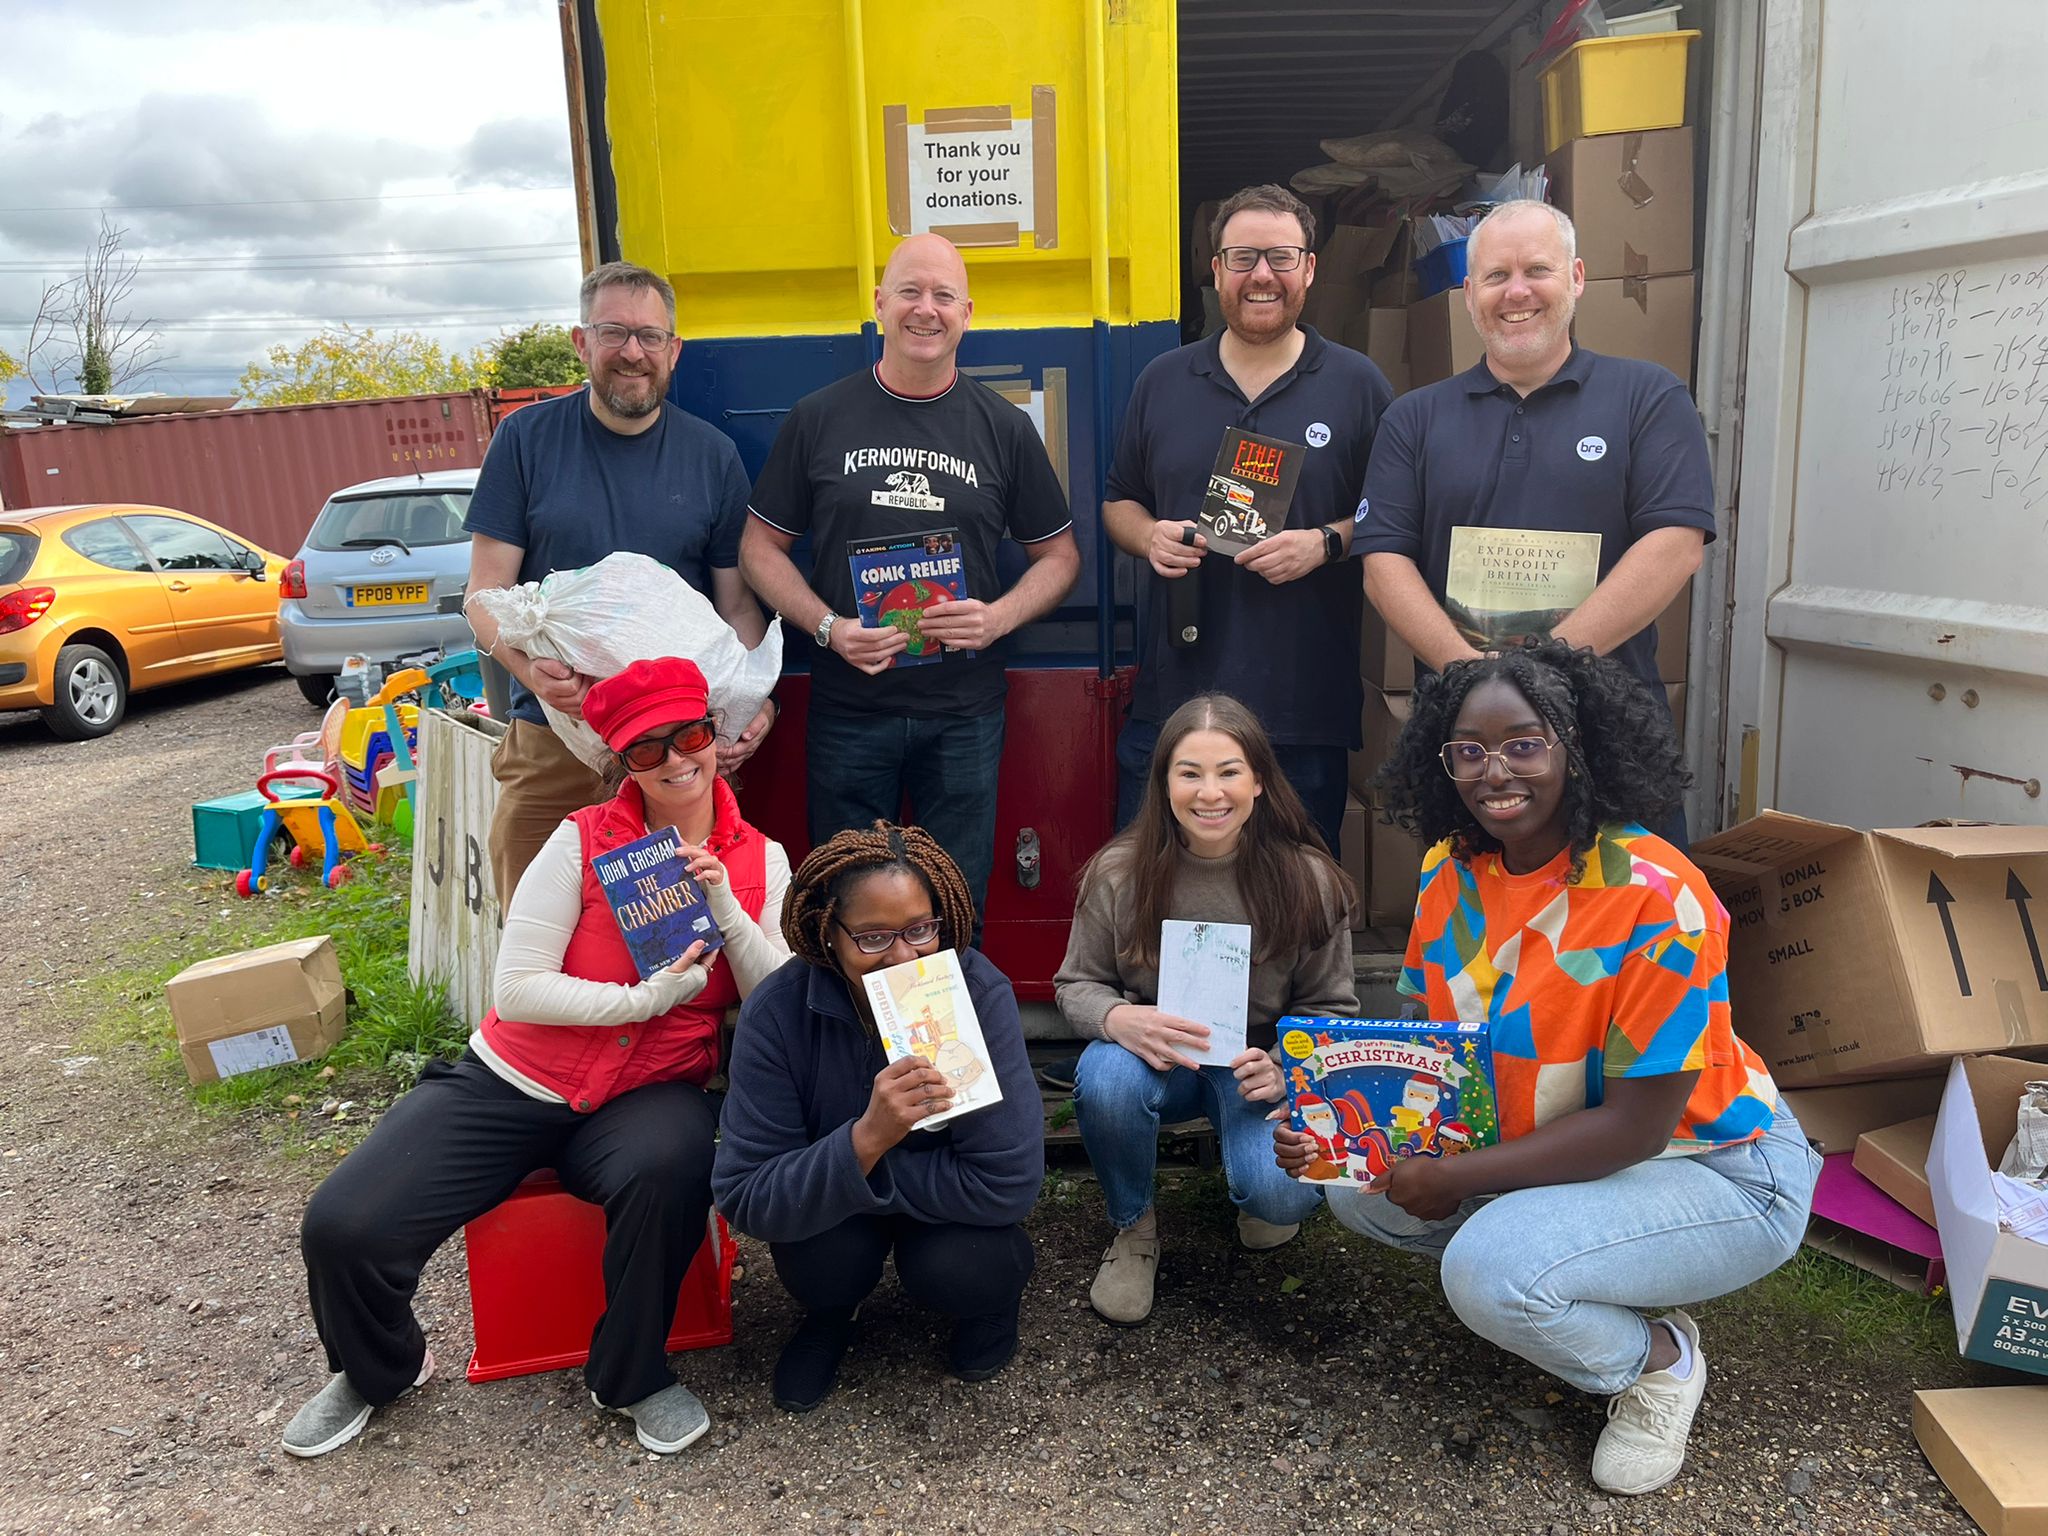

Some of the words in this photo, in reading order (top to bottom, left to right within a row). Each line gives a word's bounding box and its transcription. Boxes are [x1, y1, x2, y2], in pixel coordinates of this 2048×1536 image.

[924, 141, 981, 159] Thank
[986, 143, 1021, 161] you
[937, 167, 963, 183] for
[968, 168, 1010, 186] your
[926, 191, 1022, 208] donations.
[1308, 427, 1328, 442] bre
[1580, 441, 1603, 454] bre
[1234, 439, 1284, 478] ETHEL
[844, 448, 979, 488] KERNOWFORNIA
[888, 495, 928, 509] REPUBLIC
[1478, 545, 1566, 560] EXPLORING
[860, 564, 906, 585] COMIC
[910, 557, 961, 579] RELIEF
[1482, 557, 1559, 571] UNSPOILT
[1487, 570, 1550, 582] BRITAIN
[357, 587, 393, 603] FP08
[397, 585, 425, 600] YPF
[599, 856, 630, 886] JOHN
[627, 838, 678, 873] GRISHAM
[634, 873, 661, 897] THE
[1793, 884, 1825, 909] BOX
[616, 880, 699, 932] CHAMBER
[1767, 938, 1814, 965] SMALL
[1327, 1019, 1443, 1029] CHRISTMAS
[1324, 1049, 1442, 1073] CHRISTMAS
[1996, 1325, 2027, 1342] A3
[2012, 1318, 2020, 1326] x
[2022, 1320, 2047, 1332] 500
[1993, 1339, 2040, 1357] 80gsm
